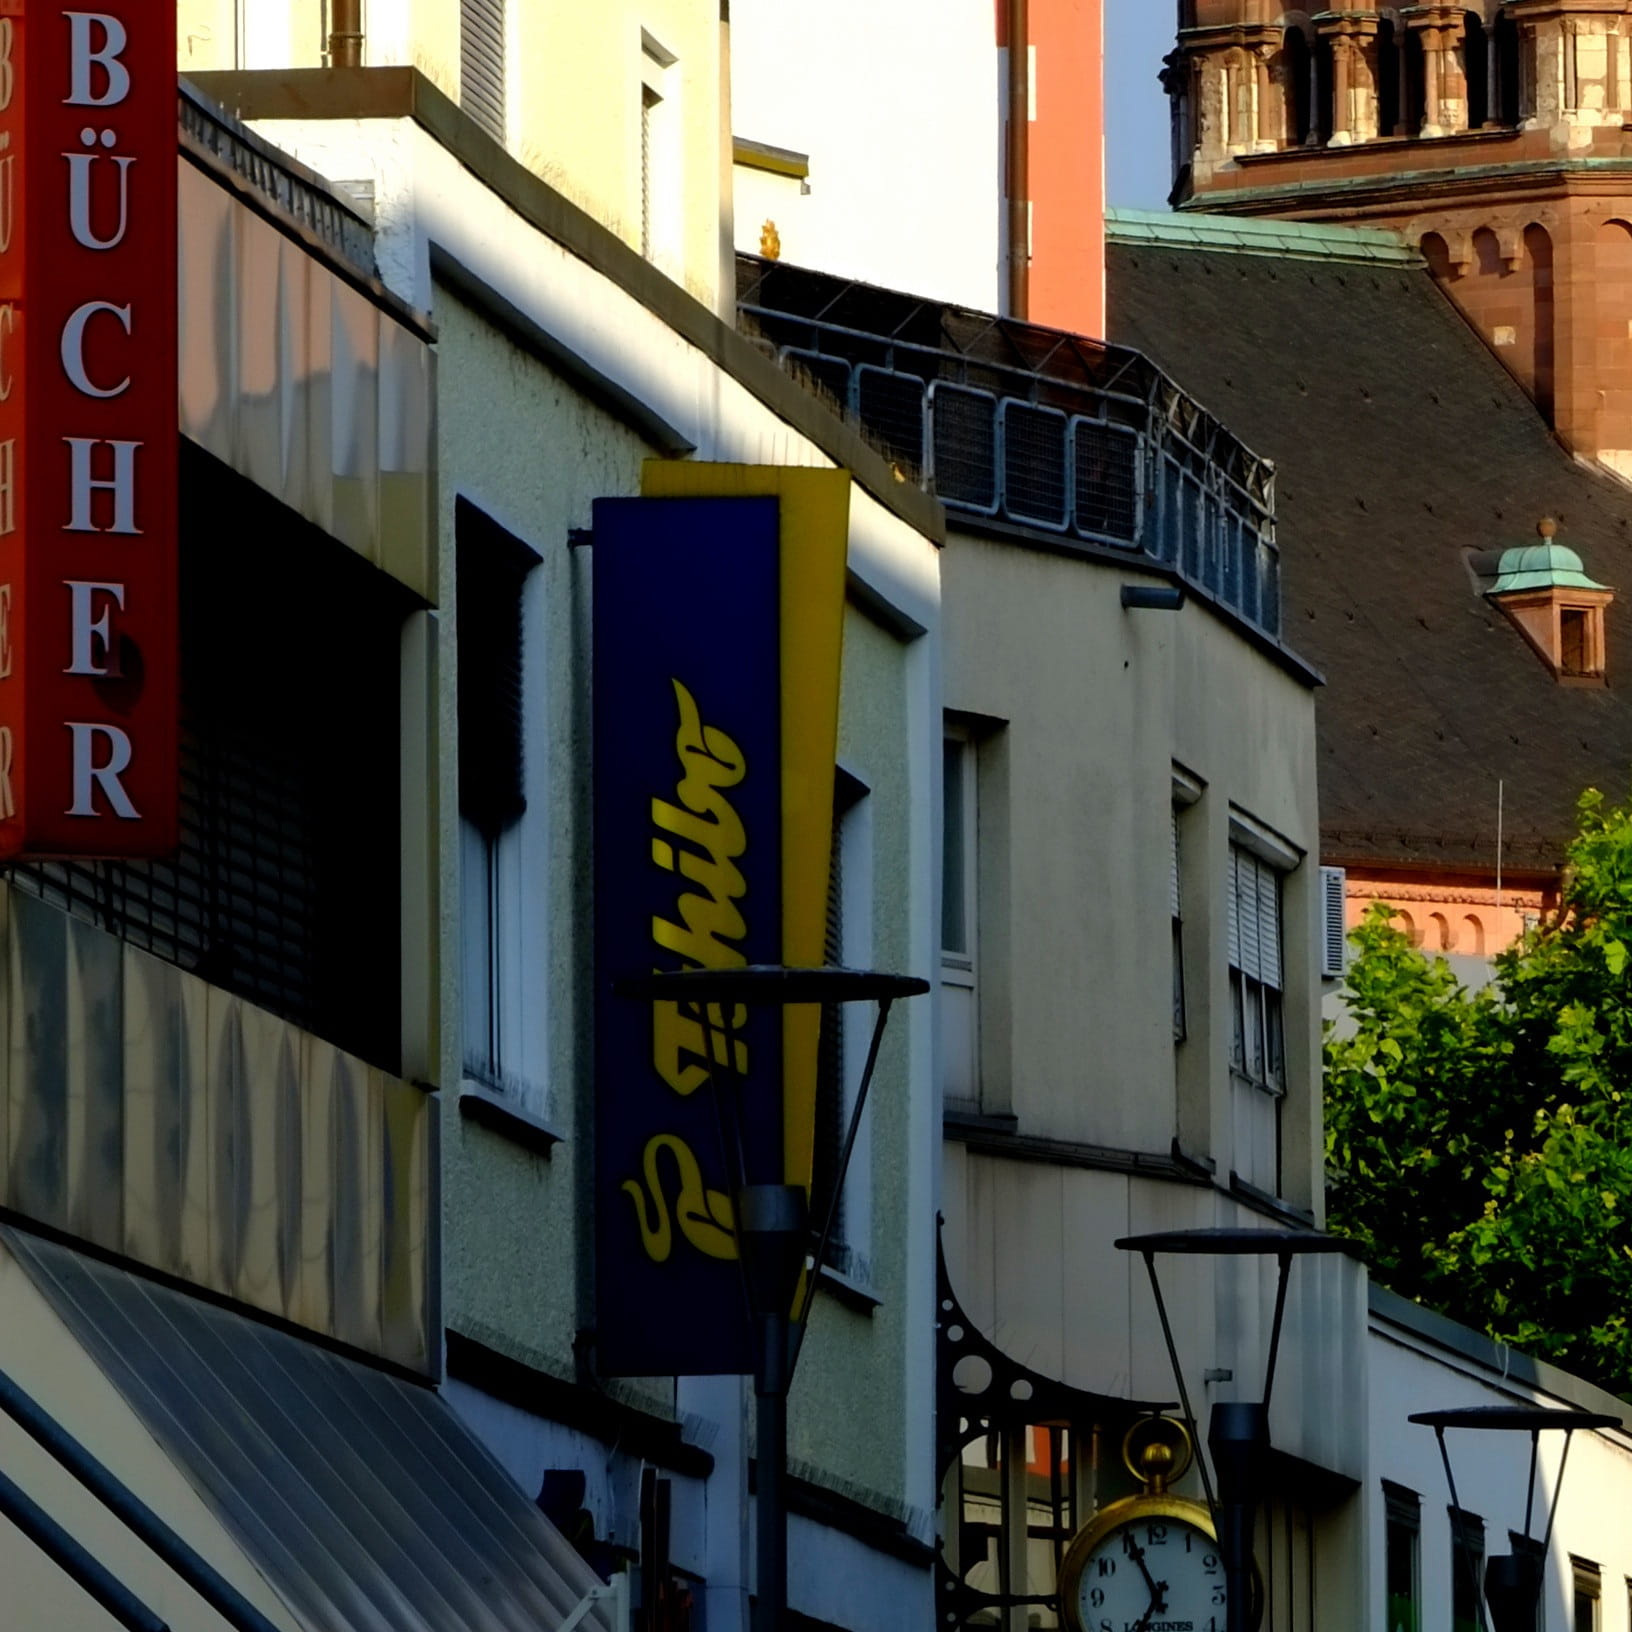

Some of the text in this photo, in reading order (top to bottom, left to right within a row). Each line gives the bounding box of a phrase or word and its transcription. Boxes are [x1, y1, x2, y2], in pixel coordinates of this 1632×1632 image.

[1147, 1525, 1167, 1546] 12
[1099, 1557, 1116, 1577] 10
[1203, 1554, 1218, 1575] 2
[1091, 1588, 1105, 1608] 9
